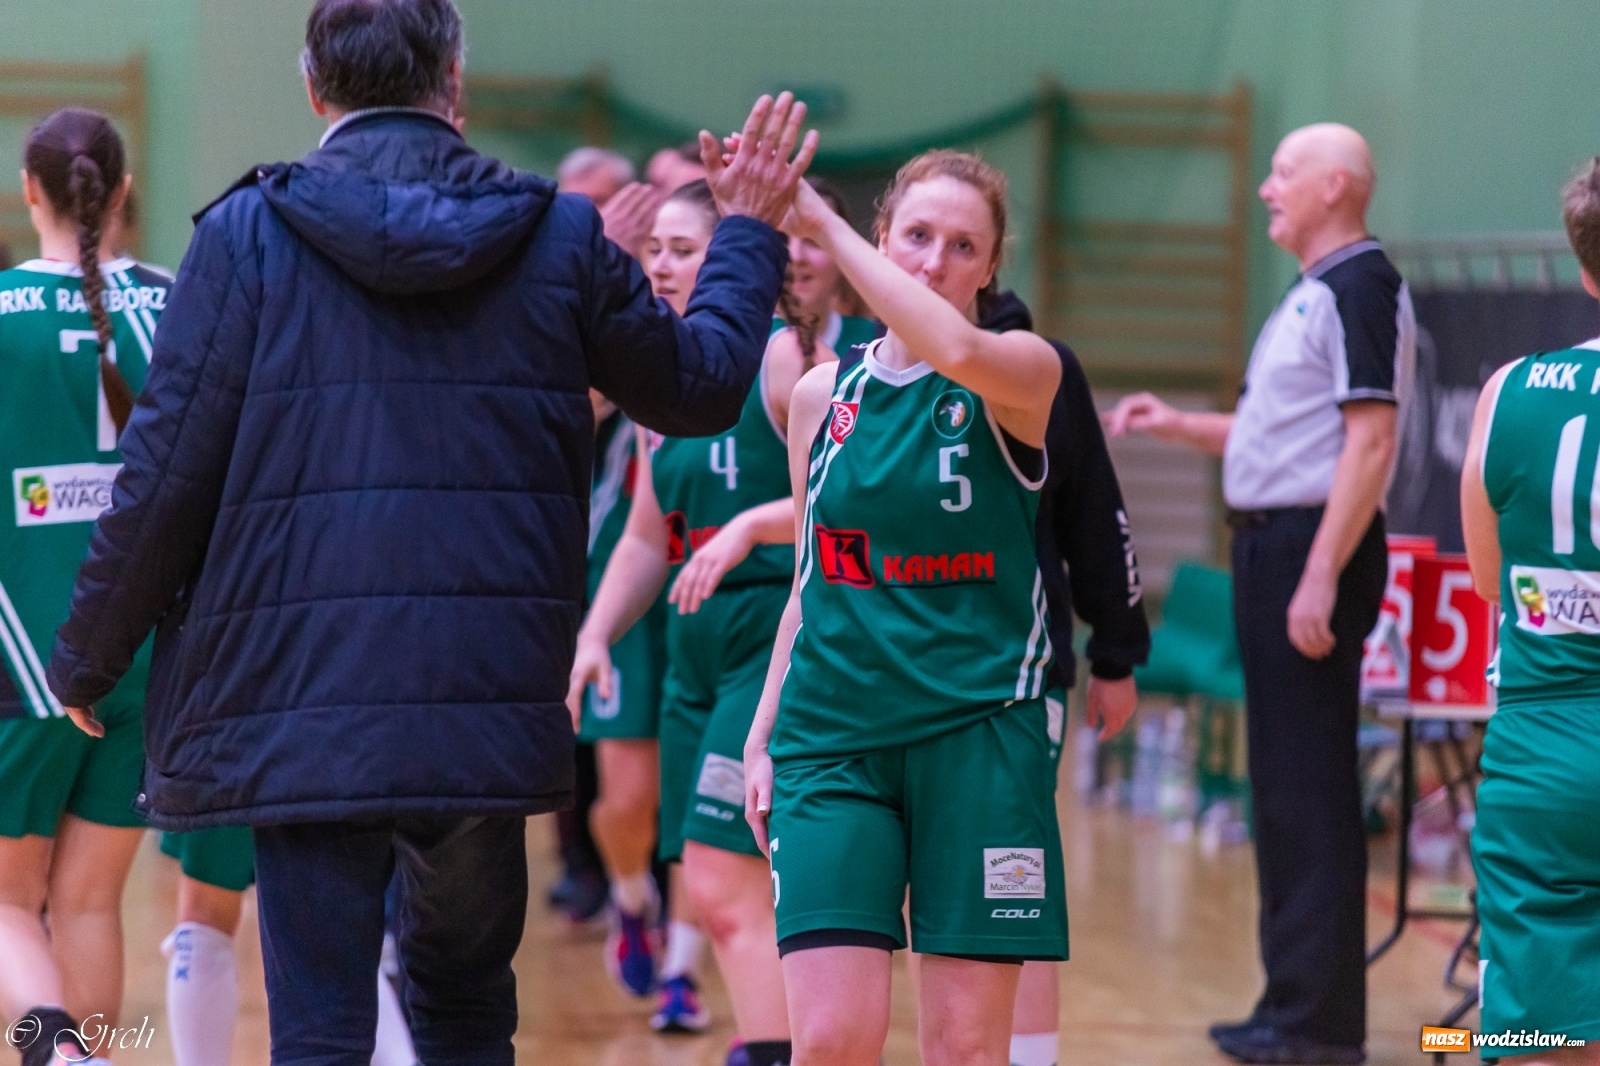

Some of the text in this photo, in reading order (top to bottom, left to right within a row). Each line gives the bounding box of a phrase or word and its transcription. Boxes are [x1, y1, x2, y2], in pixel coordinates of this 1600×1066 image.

[0, 286, 47, 315] RKK
[60, 329, 117, 451] 7
[1526, 362, 1583, 391] RKK
[710, 436, 739, 490] 4
[939, 443, 972, 512] 5
[883, 551, 996, 583] KAMAN
[1420, 570, 1474, 672] 5
[990, 883, 1019, 891] Marcin
[990, 908, 1041, 919] COLO
